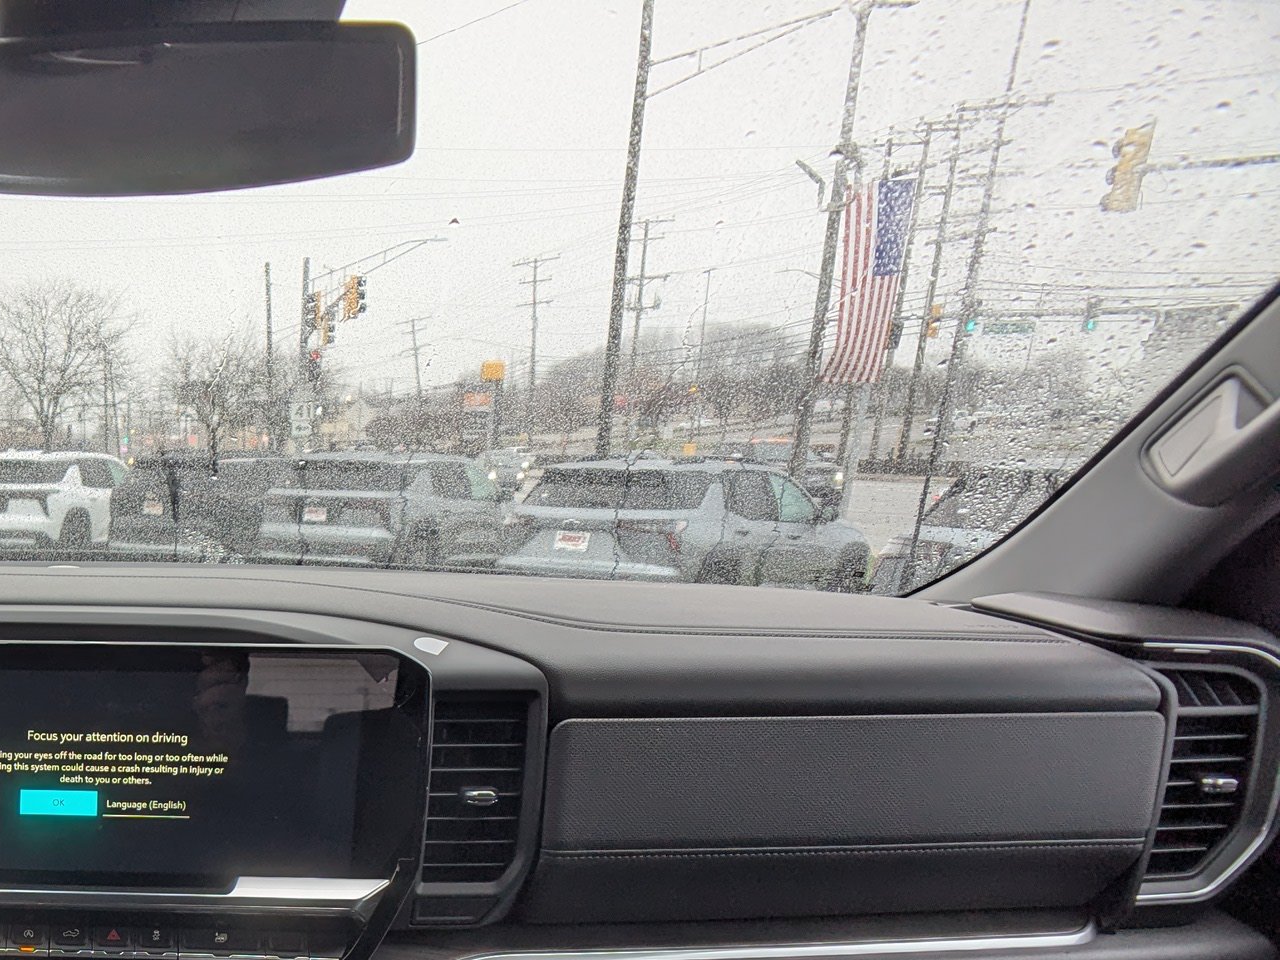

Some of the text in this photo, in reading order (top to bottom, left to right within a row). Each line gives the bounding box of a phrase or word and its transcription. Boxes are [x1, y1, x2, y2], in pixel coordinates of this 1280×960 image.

[27, 730, 188, 746] Focus your attention on driving
[14, 753, 32, 761] your
[34, 753, 53, 762] eyes
[54, 751, 68, 760] off
[68, 751, 82, 760] the
[84, 752, 103, 760] road
[104, 752, 117, 761] for
[119, 753, 133, 761] too
[135, 752, 153, 763] long
[166, 753, 180, 762] too
[182, 753, 204, 762] often
[206, 753, 229, 763] while
[14, 762, 29, 771] this
[31, 764, 60, 773] system
[61, 763, 84, 772] could
[118, 764, 140, 773] crash
[142, 765, 179, 775] resulting
[180, 765, 188, 774] in
[190, 765, 213, 776] injury
[214, 767, 224, 775] or
[60, 775, 84, 784] death
[85, 776, 94, 784] to
[95, 777, 110, 786] you
[123, 776, 152, 785] others.
[52, 799, 65, 807] OK
[107, 800, 187, 812] Language (English)
